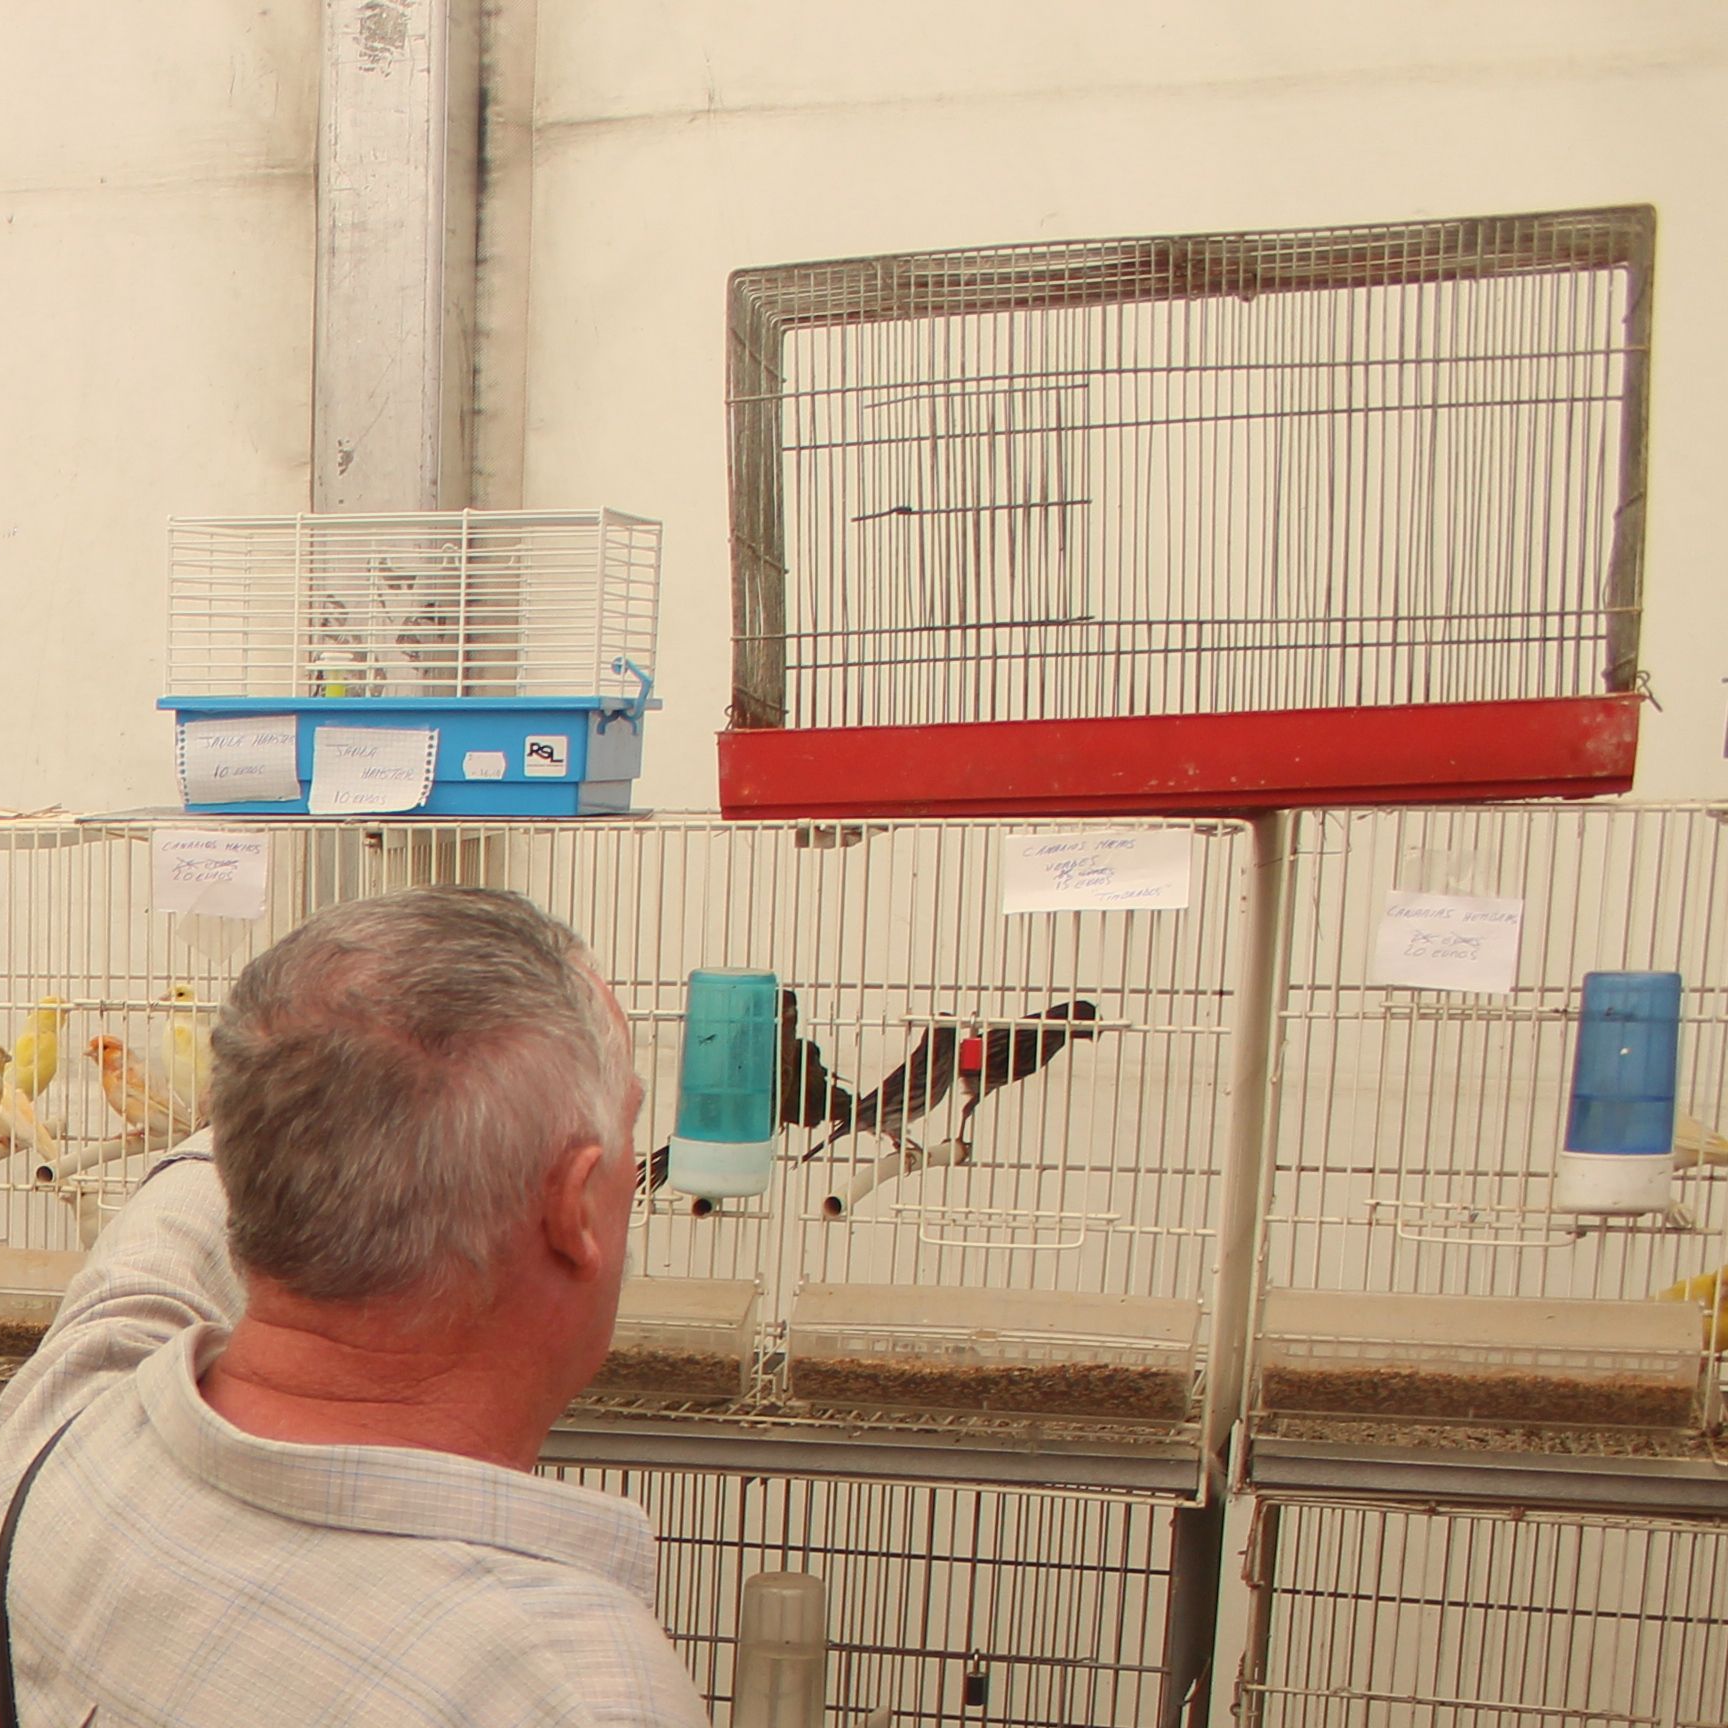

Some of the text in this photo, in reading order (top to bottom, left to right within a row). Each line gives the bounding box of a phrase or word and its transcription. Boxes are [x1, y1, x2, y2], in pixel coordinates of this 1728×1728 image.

[213, 764, 229, 779] 10
[334, 790, 350, 805] 10
[1403, 943, 1426, 958] 20
